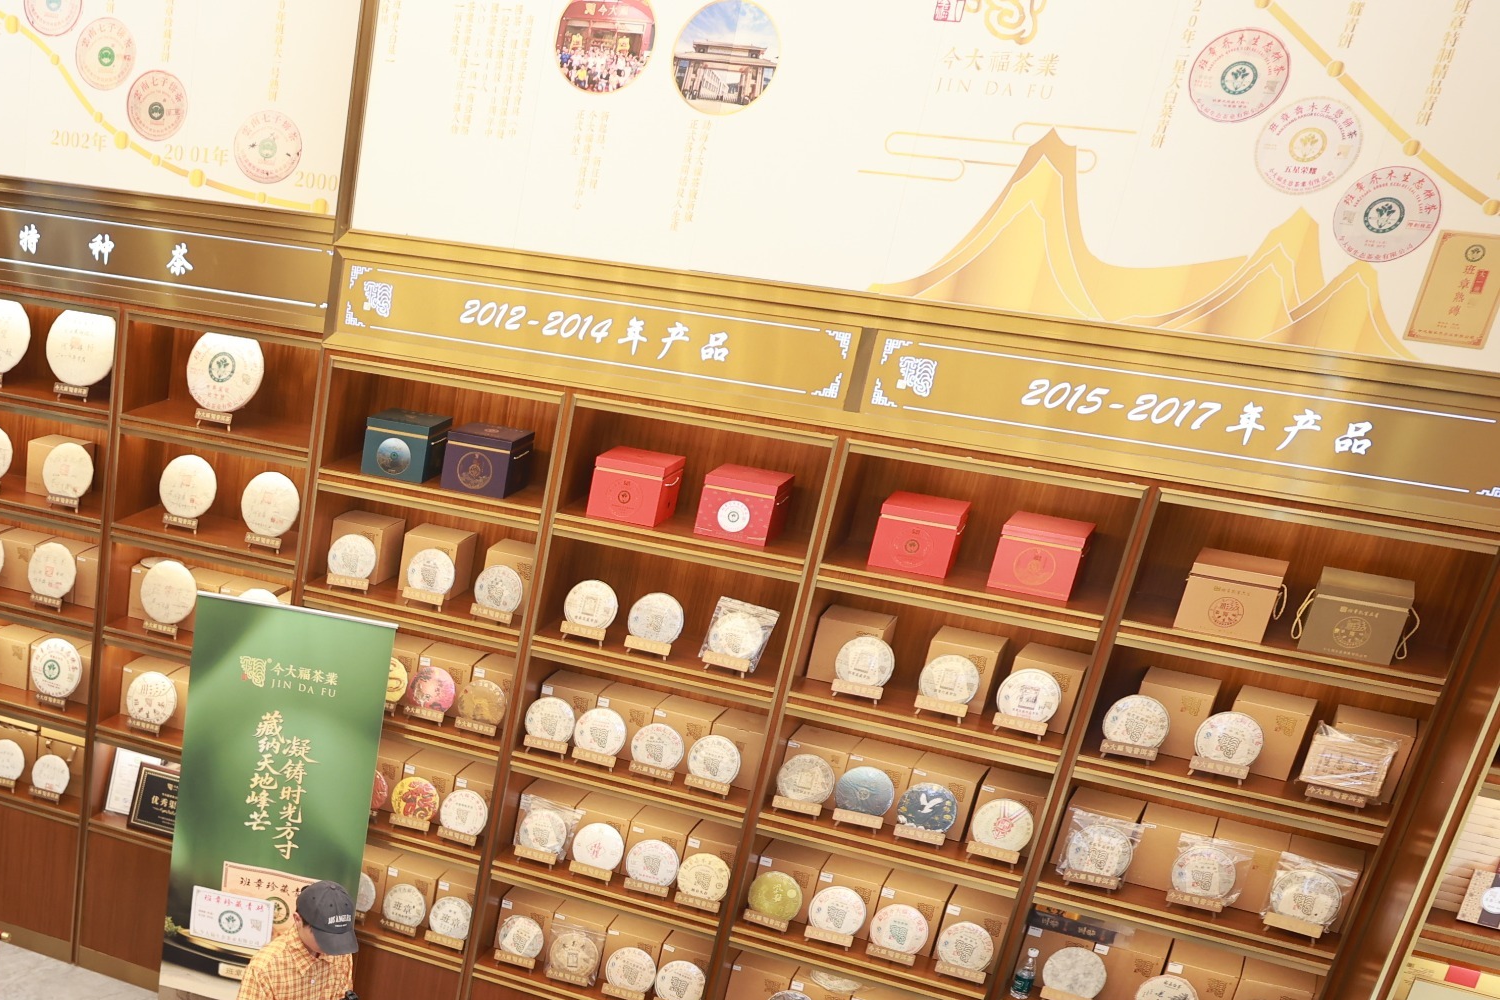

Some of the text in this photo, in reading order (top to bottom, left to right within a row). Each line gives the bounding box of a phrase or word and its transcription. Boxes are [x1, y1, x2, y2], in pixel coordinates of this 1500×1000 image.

[933, 77, 1055, 100] JIN DA FU
[270, 662, 339, 686] 今大福茶業
[270, 678, 337, 698] JIN DA FU
[243, 710, 285, 831] 藏纳天地峰芒
[272, 735, 321, 860] 凝铸时光方寸
